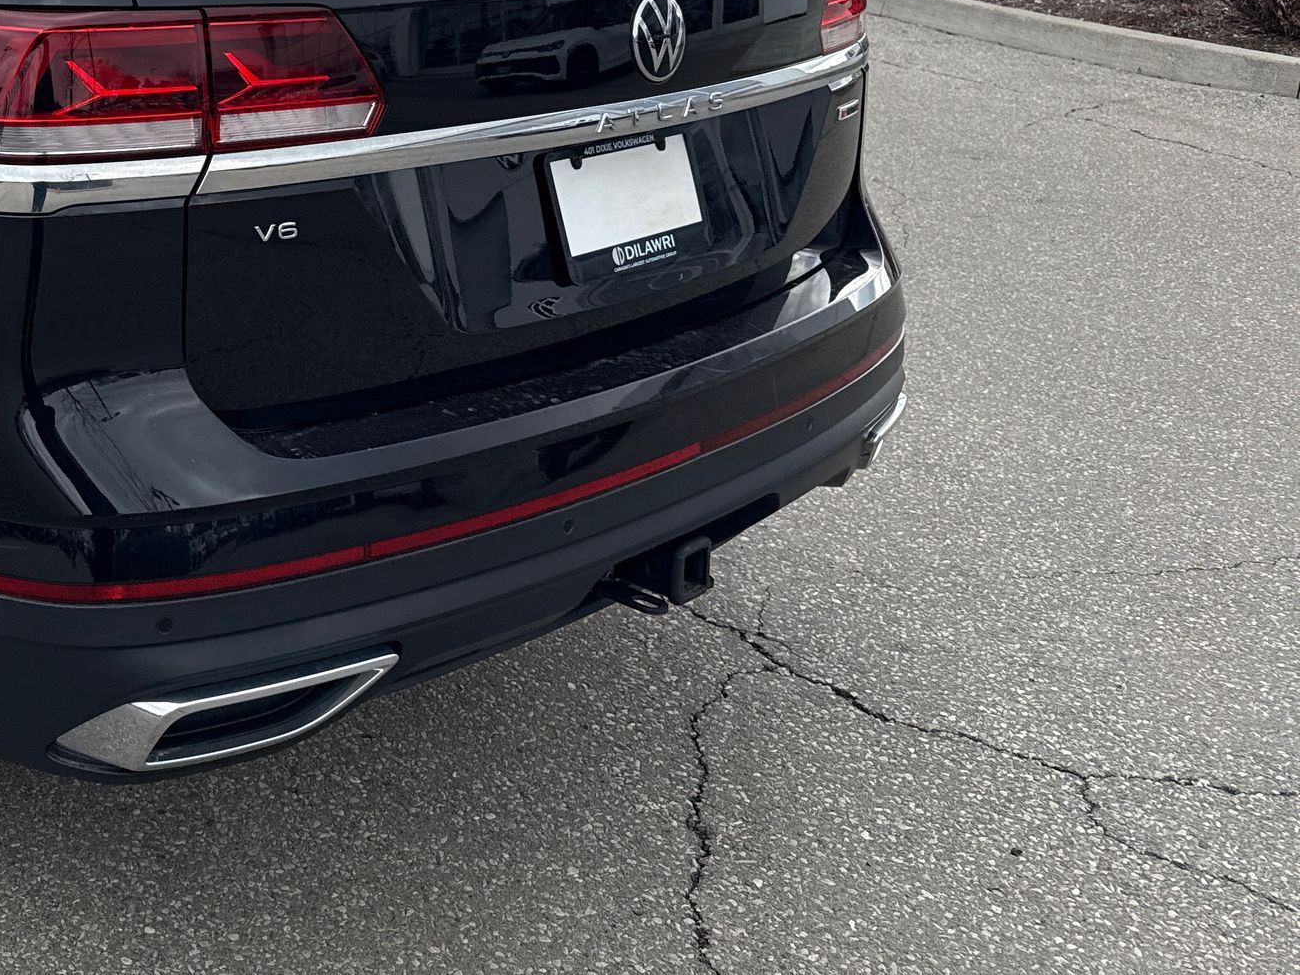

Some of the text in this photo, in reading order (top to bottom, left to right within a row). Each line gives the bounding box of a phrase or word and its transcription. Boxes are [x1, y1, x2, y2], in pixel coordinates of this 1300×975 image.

[596, 91, 723, 133] ATLAS
[584, 134, 655, 155] 401 DIXIE VOLKSWAGEN
[253, 221, 298, 242] V6
[624, 234, 676, 260] DILAWRI
